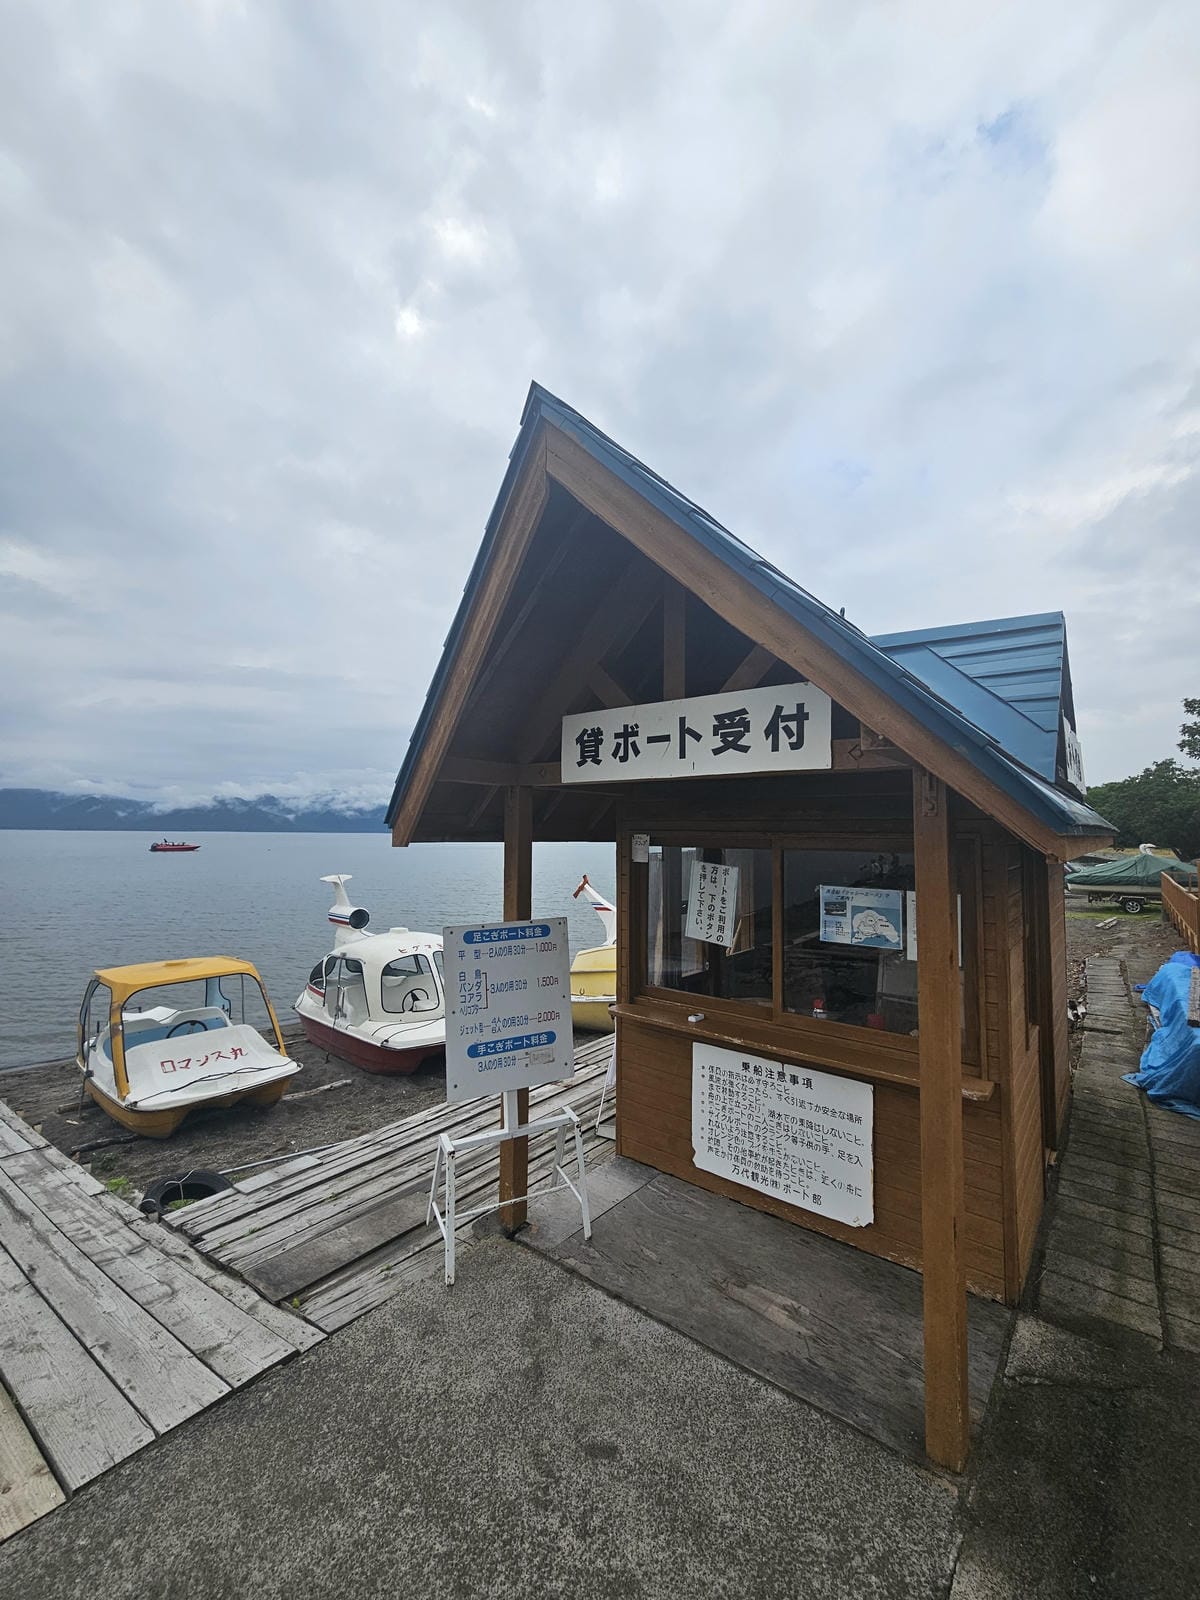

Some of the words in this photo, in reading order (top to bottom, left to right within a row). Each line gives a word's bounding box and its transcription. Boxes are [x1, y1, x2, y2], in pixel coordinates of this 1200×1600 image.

[575, 703, 810, 767] 貸ボート受付
[716, 867, 730, 943] ボートをご利用の
[473, 926, 543, 942] 足こぎボート料金
[460, 992, 482, 1004] コアラ
[477, 1033, 548, 1055] 手こぎボート料金
[160, 1047, 248, 1074] ロマンス丸
[741, 1061, 814, 1090] 乗船注意事項
